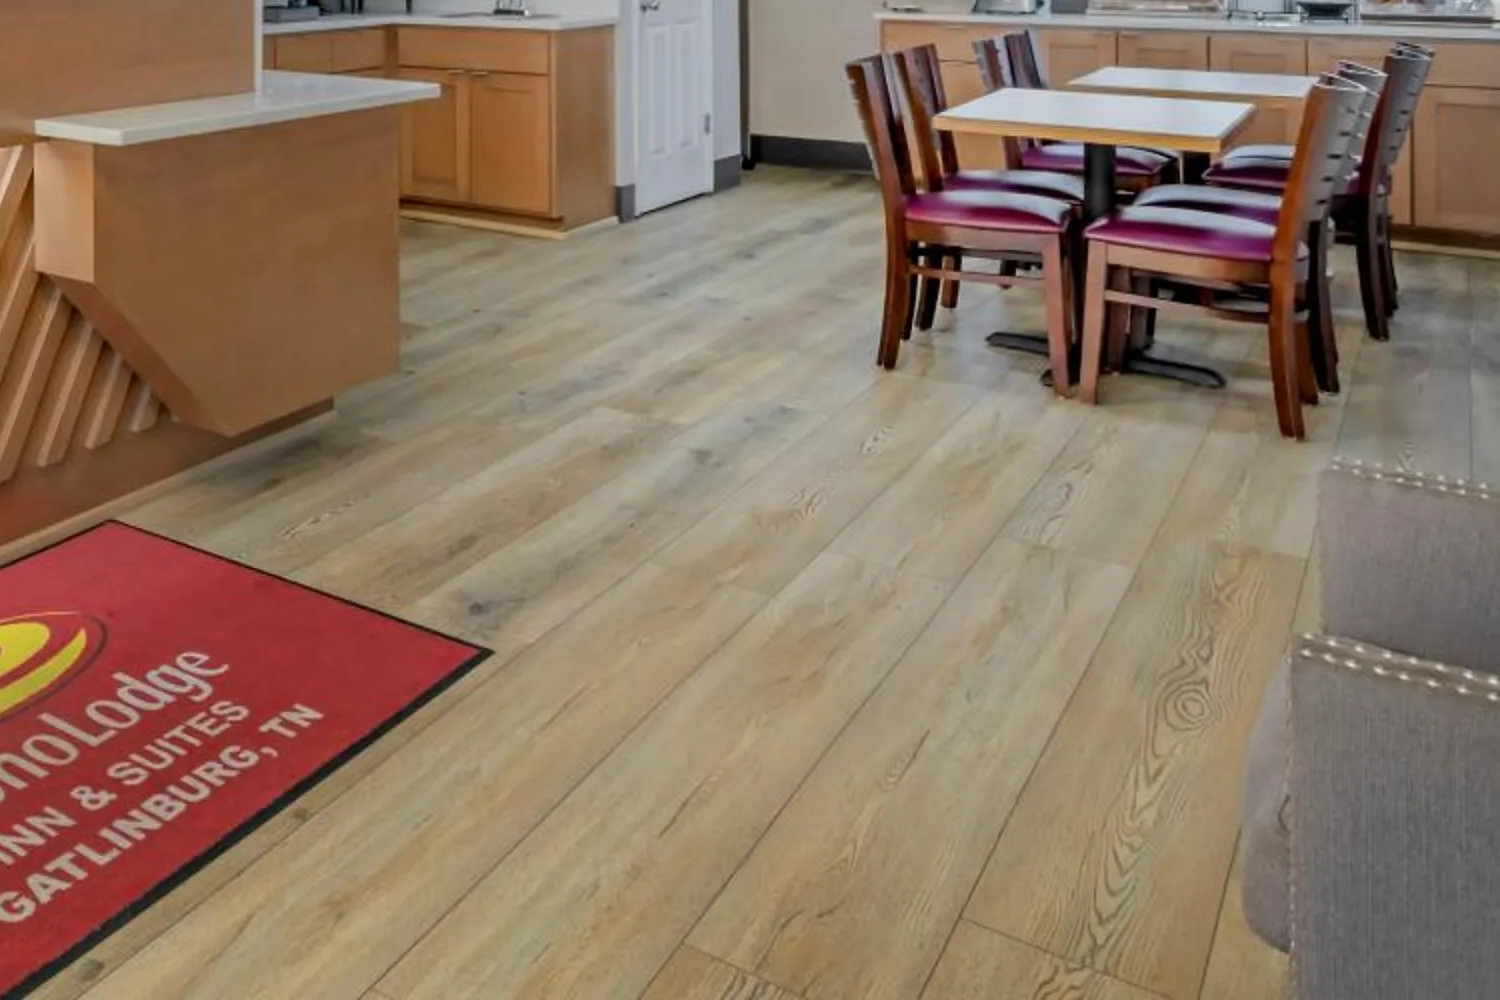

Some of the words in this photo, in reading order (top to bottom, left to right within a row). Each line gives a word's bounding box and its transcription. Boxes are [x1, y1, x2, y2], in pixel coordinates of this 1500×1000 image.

[71, 784, 116, 812] &
[107, 699, 250, 786] SUITES
[259, 703, 324, 739] TN
